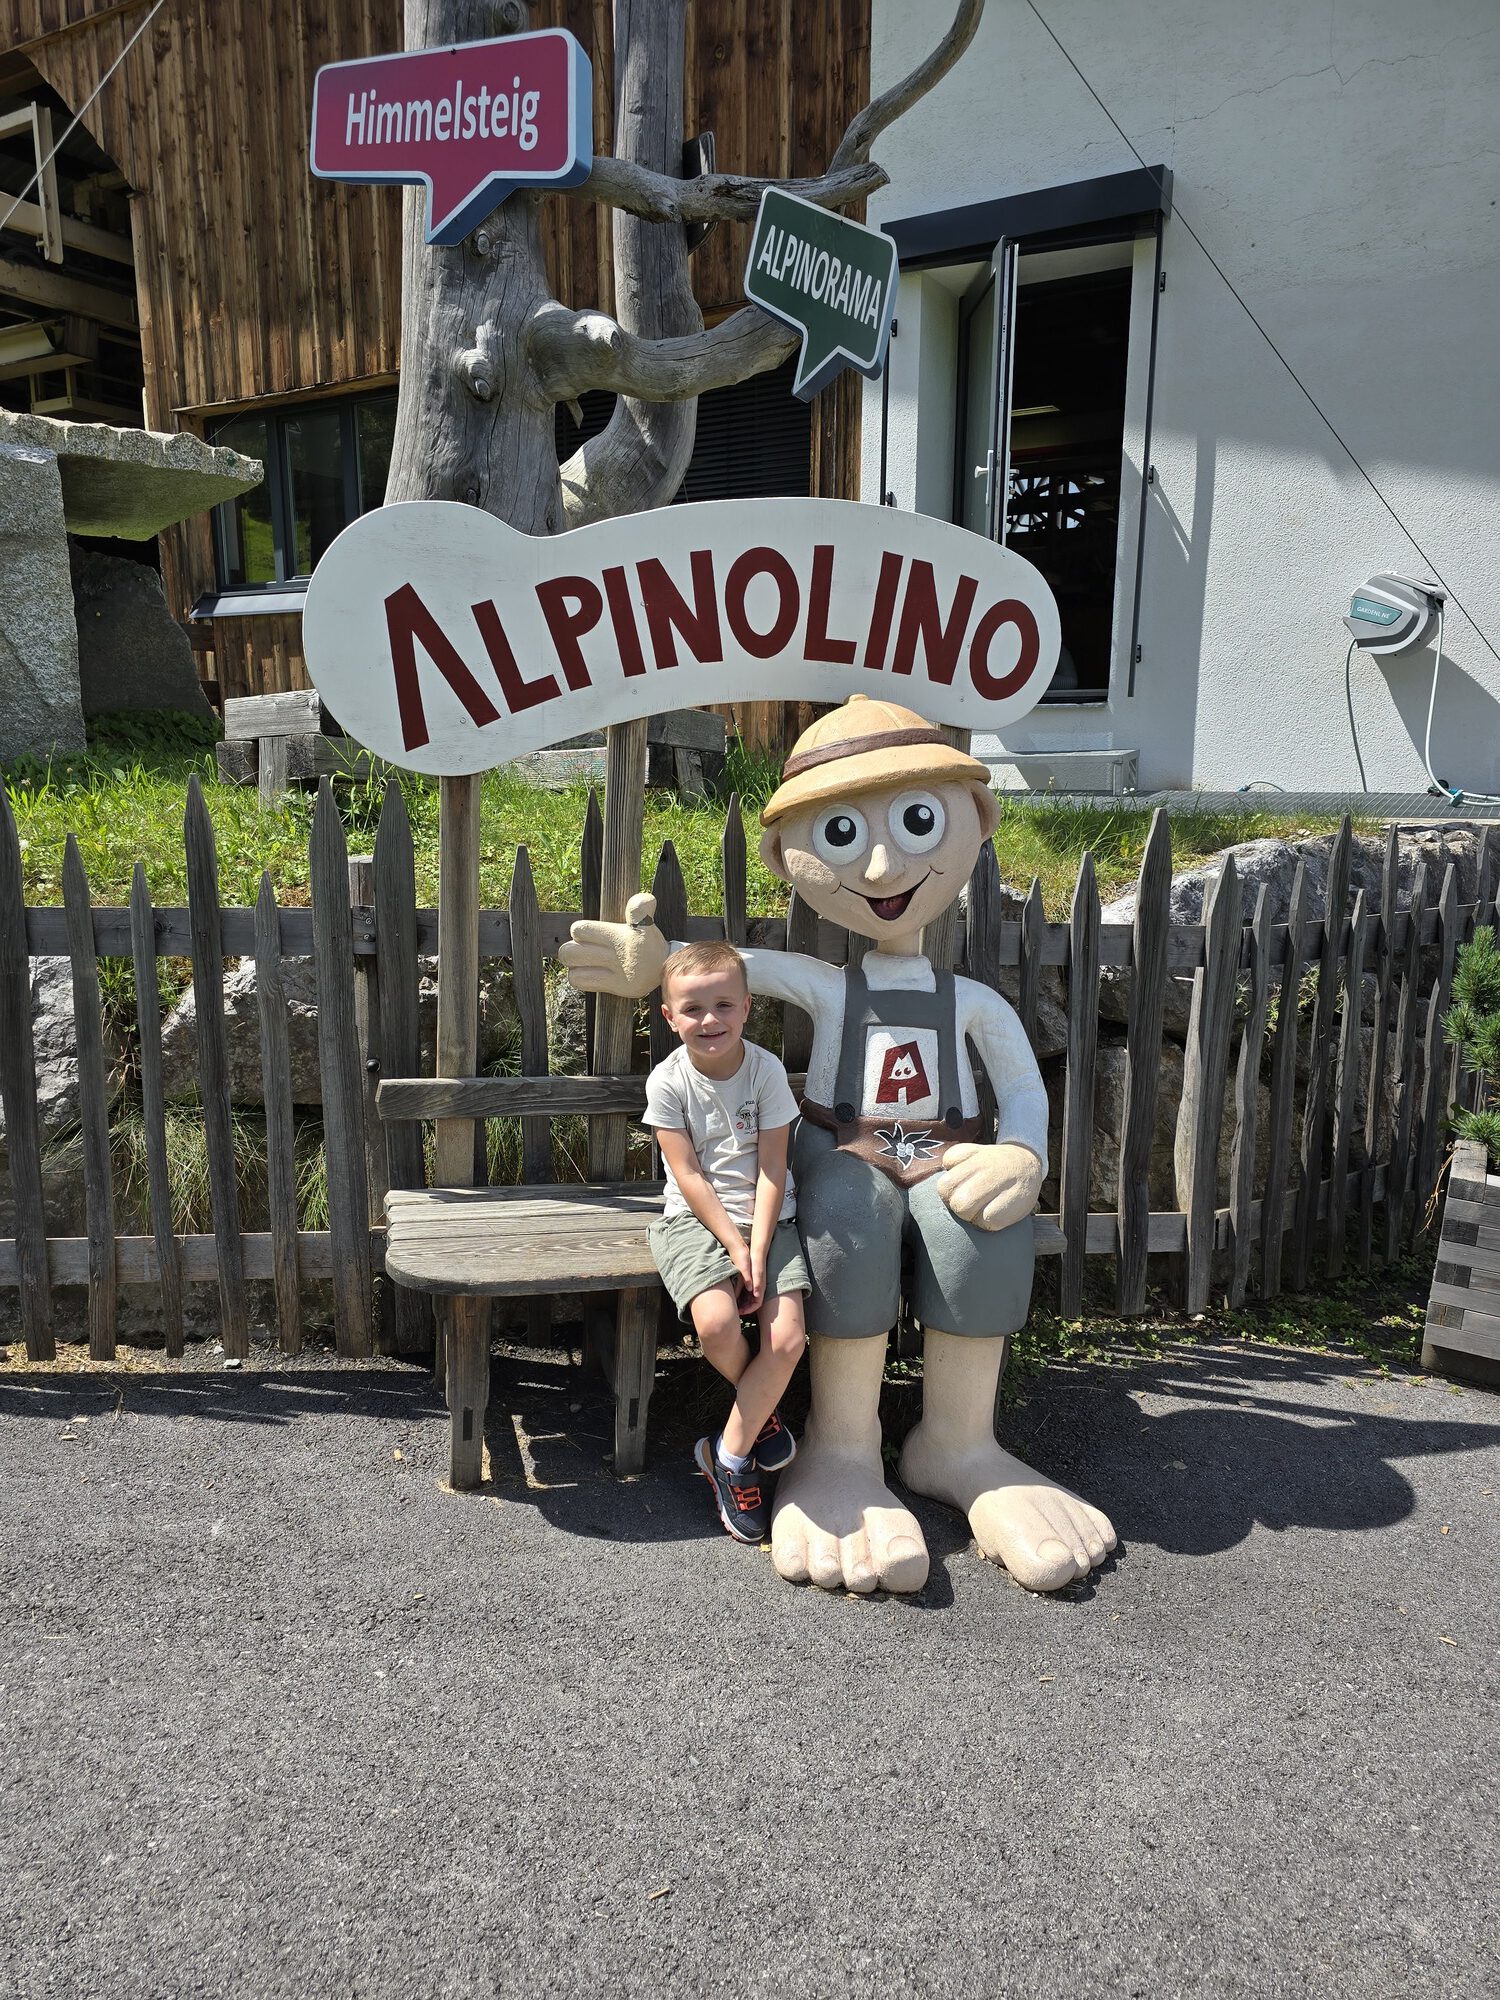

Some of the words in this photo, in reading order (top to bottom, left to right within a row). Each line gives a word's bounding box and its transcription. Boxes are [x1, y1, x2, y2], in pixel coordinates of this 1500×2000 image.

[345, 75, 541, 152] Himmelsteig
[756, 224, 882, 330] ALPINORAMA
[384, 545, 1041, 752] ALPINOLINO
[1356, 606, 1390, 619] GARDENLNE
